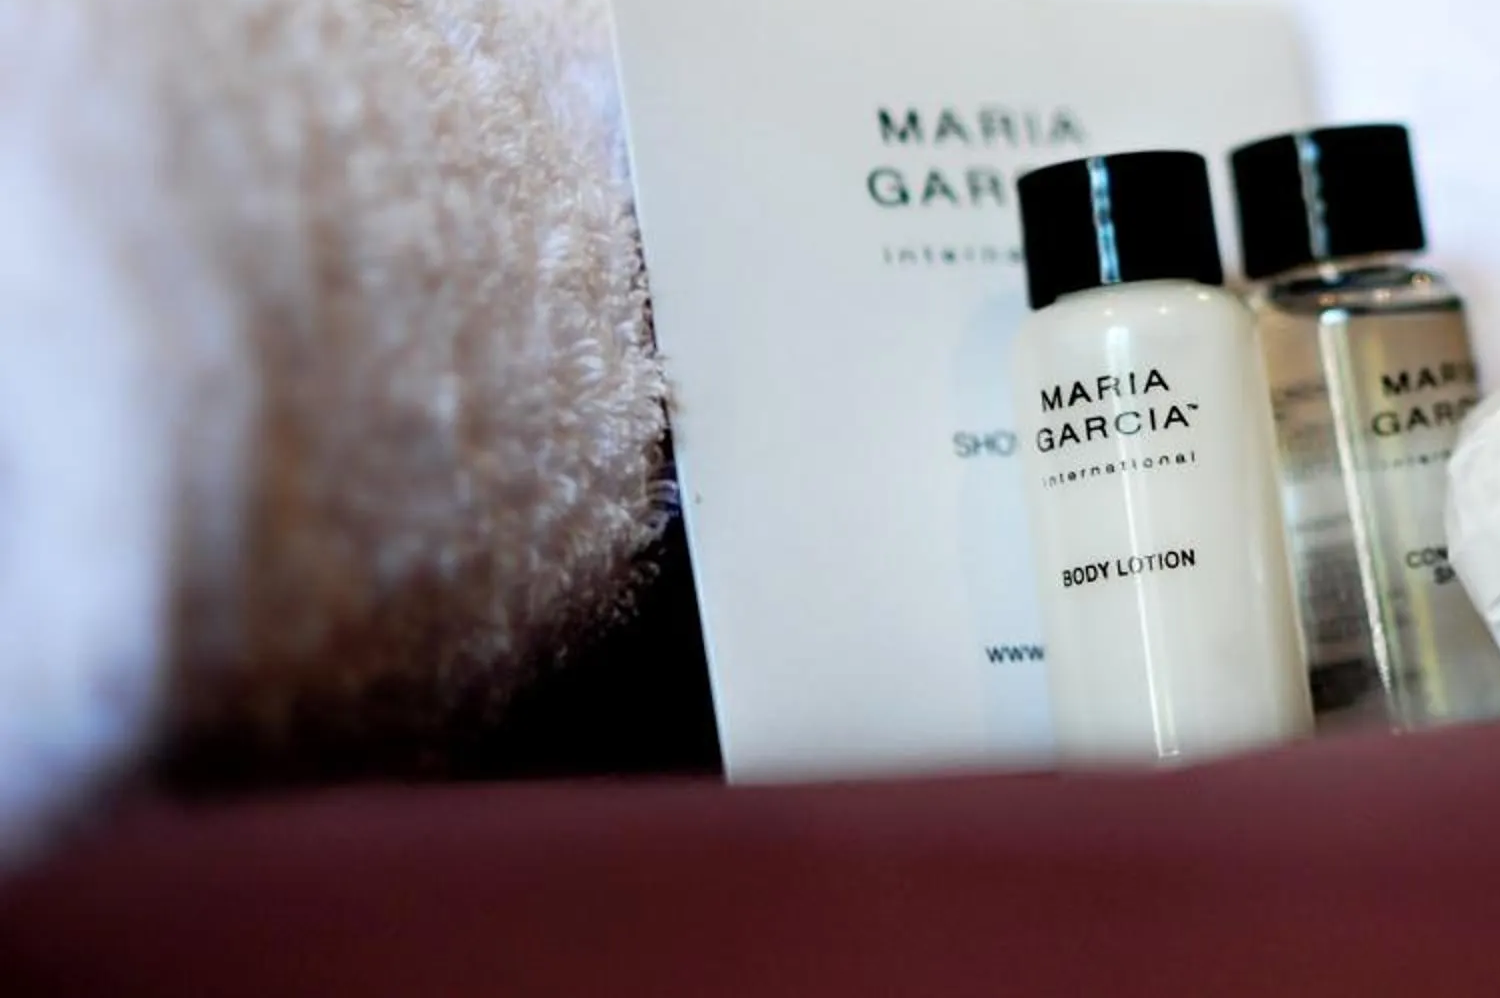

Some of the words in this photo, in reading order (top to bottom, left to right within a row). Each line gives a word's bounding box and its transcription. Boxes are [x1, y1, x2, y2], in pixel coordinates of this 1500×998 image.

[875, 107, 1086, 145] MARIA
[867, 166, 1020, 207] GAR
[1040, 368, 1170, 413] MARIA
[952, 429, 1019, 459] SHO
[1042, 451, 1196, 487] international
[1062, 561, 1109, 588] BODY
[1117, 549, 1196, 578] LOTION
